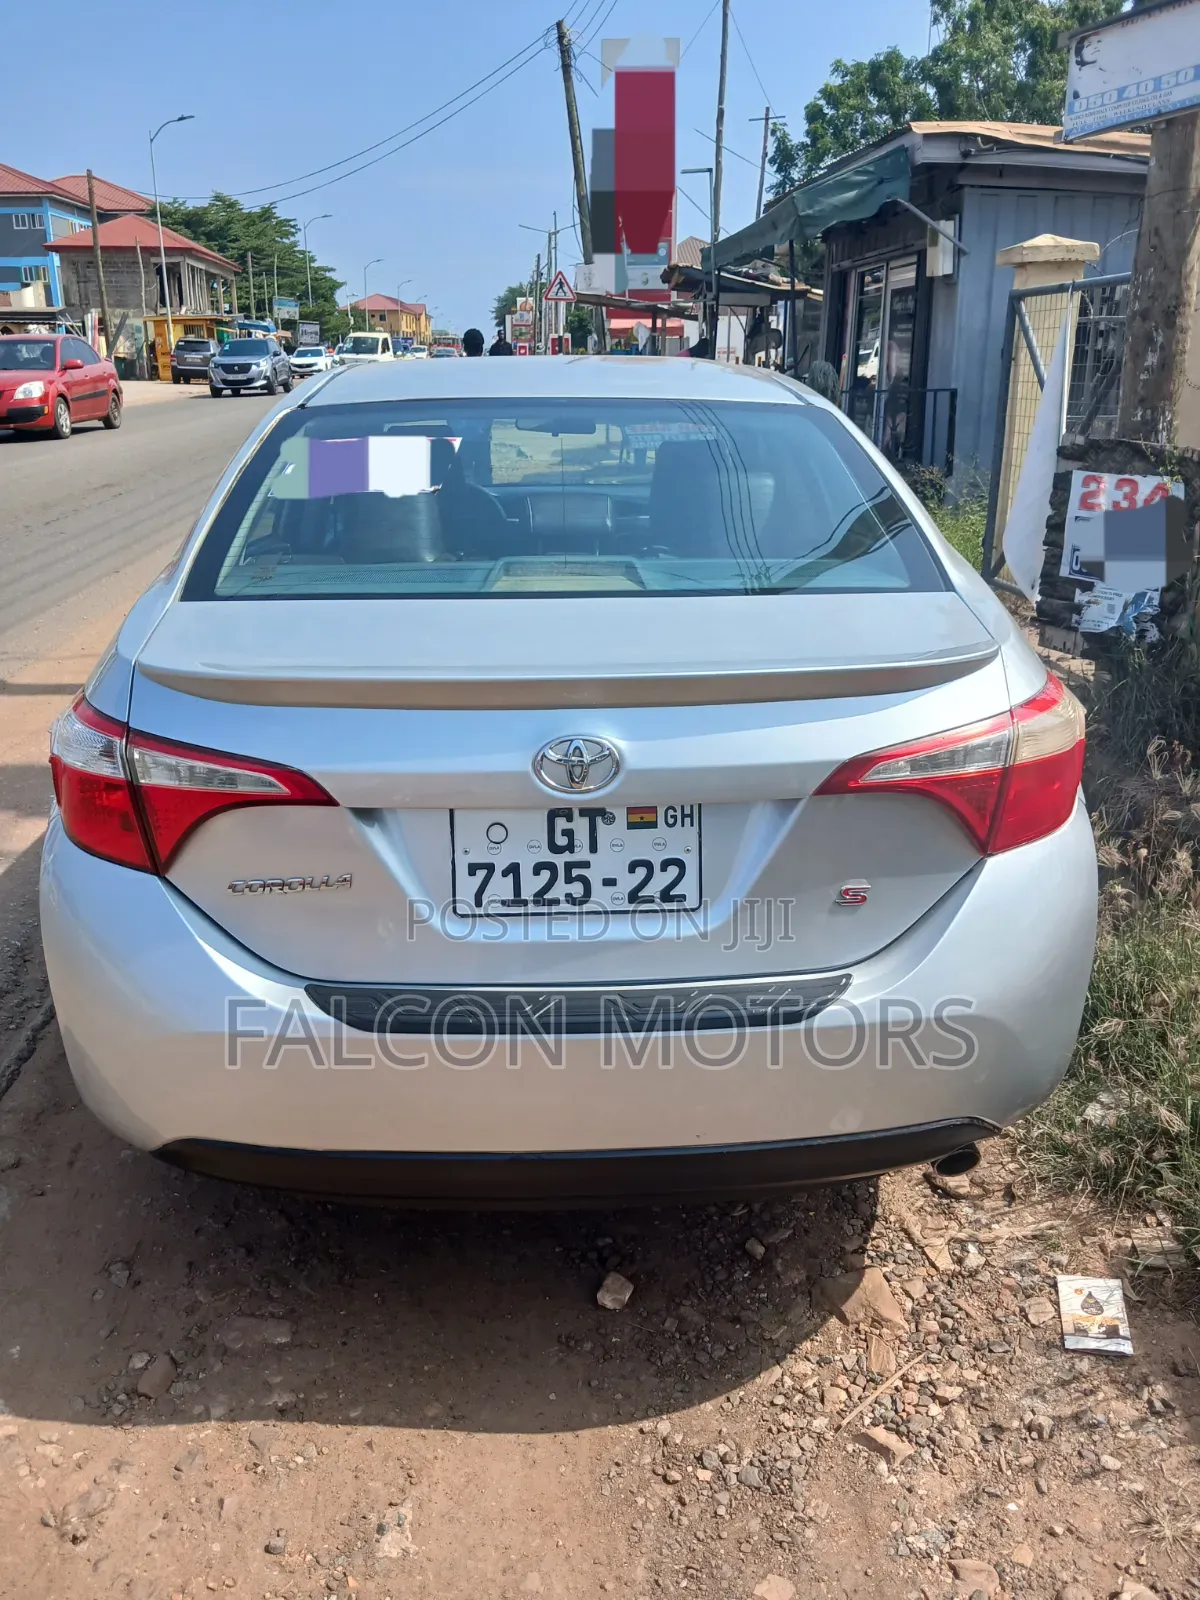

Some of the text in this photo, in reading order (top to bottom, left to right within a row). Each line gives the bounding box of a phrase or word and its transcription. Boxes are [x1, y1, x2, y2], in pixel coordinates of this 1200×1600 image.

[1074, 67, 1195, 113] 050 40 50
[1108, 100, 1130, 111] COMPUTER
[664, 804, 694, 828] GH
[547, 807, 606, 854] GT
[227, 873, 352, 896] COROLLA
[467, 857, 687, 908] 7125-22
[834, 879, 872, 907] S
